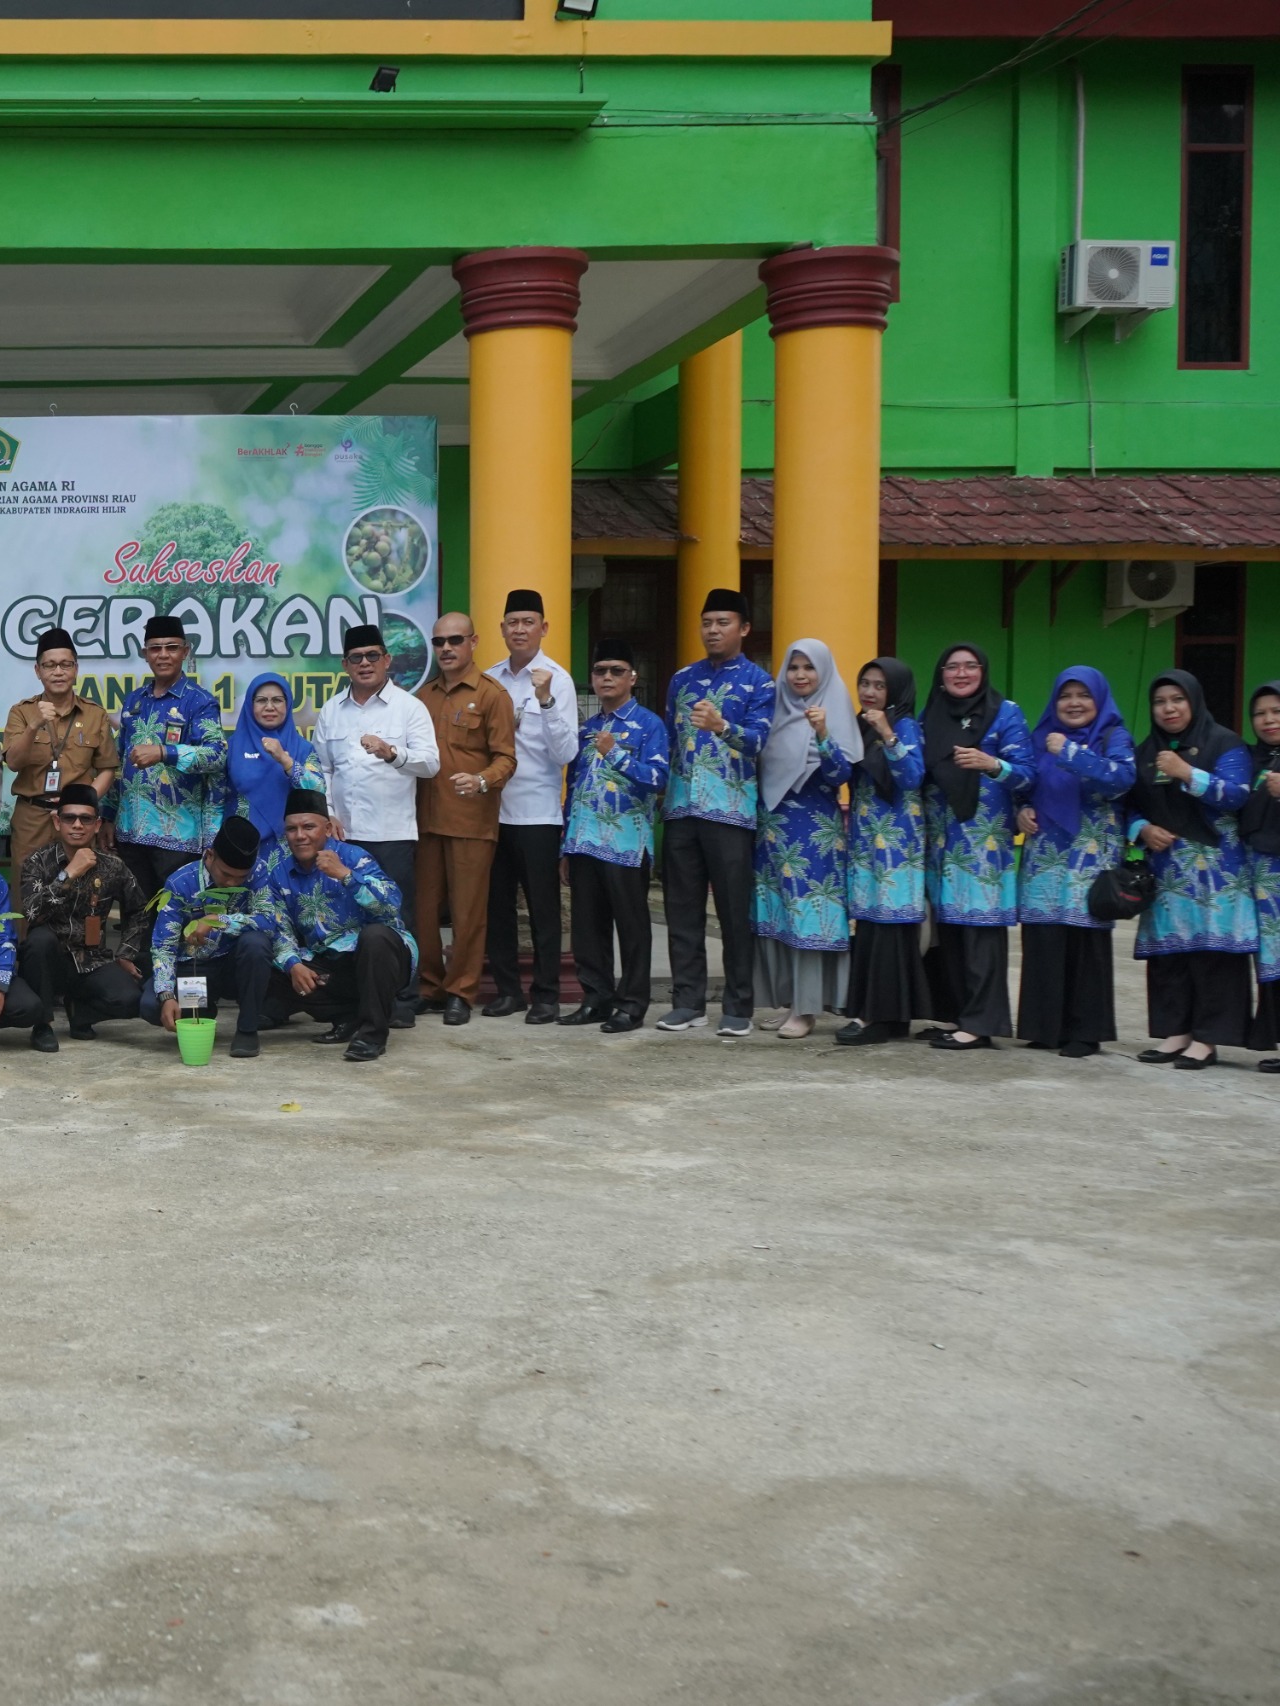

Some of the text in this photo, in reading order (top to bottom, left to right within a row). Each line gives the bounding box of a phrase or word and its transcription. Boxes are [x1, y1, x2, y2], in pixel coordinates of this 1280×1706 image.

[237, 447, 288, 456] BerAKHLAK
[334, 453, 363, 461] pusaka
[11, 481, 58, 492] AGAMA
[61, 481, 76, 491] RI
[22, 495, 59, 504] AGAMA
[61, 494, 109, 504] PROVINSI
[111, 494, 137, 503] RIAU
[0, 507, 51, 515] KABUPATEN
[53, 506, 100, 514] INDRAGIRI
[102, 506, 127, 514] HILIR
[104, 540, 282, 587] Sukseskan
[0, 594, 383, 661] GERAKAN
